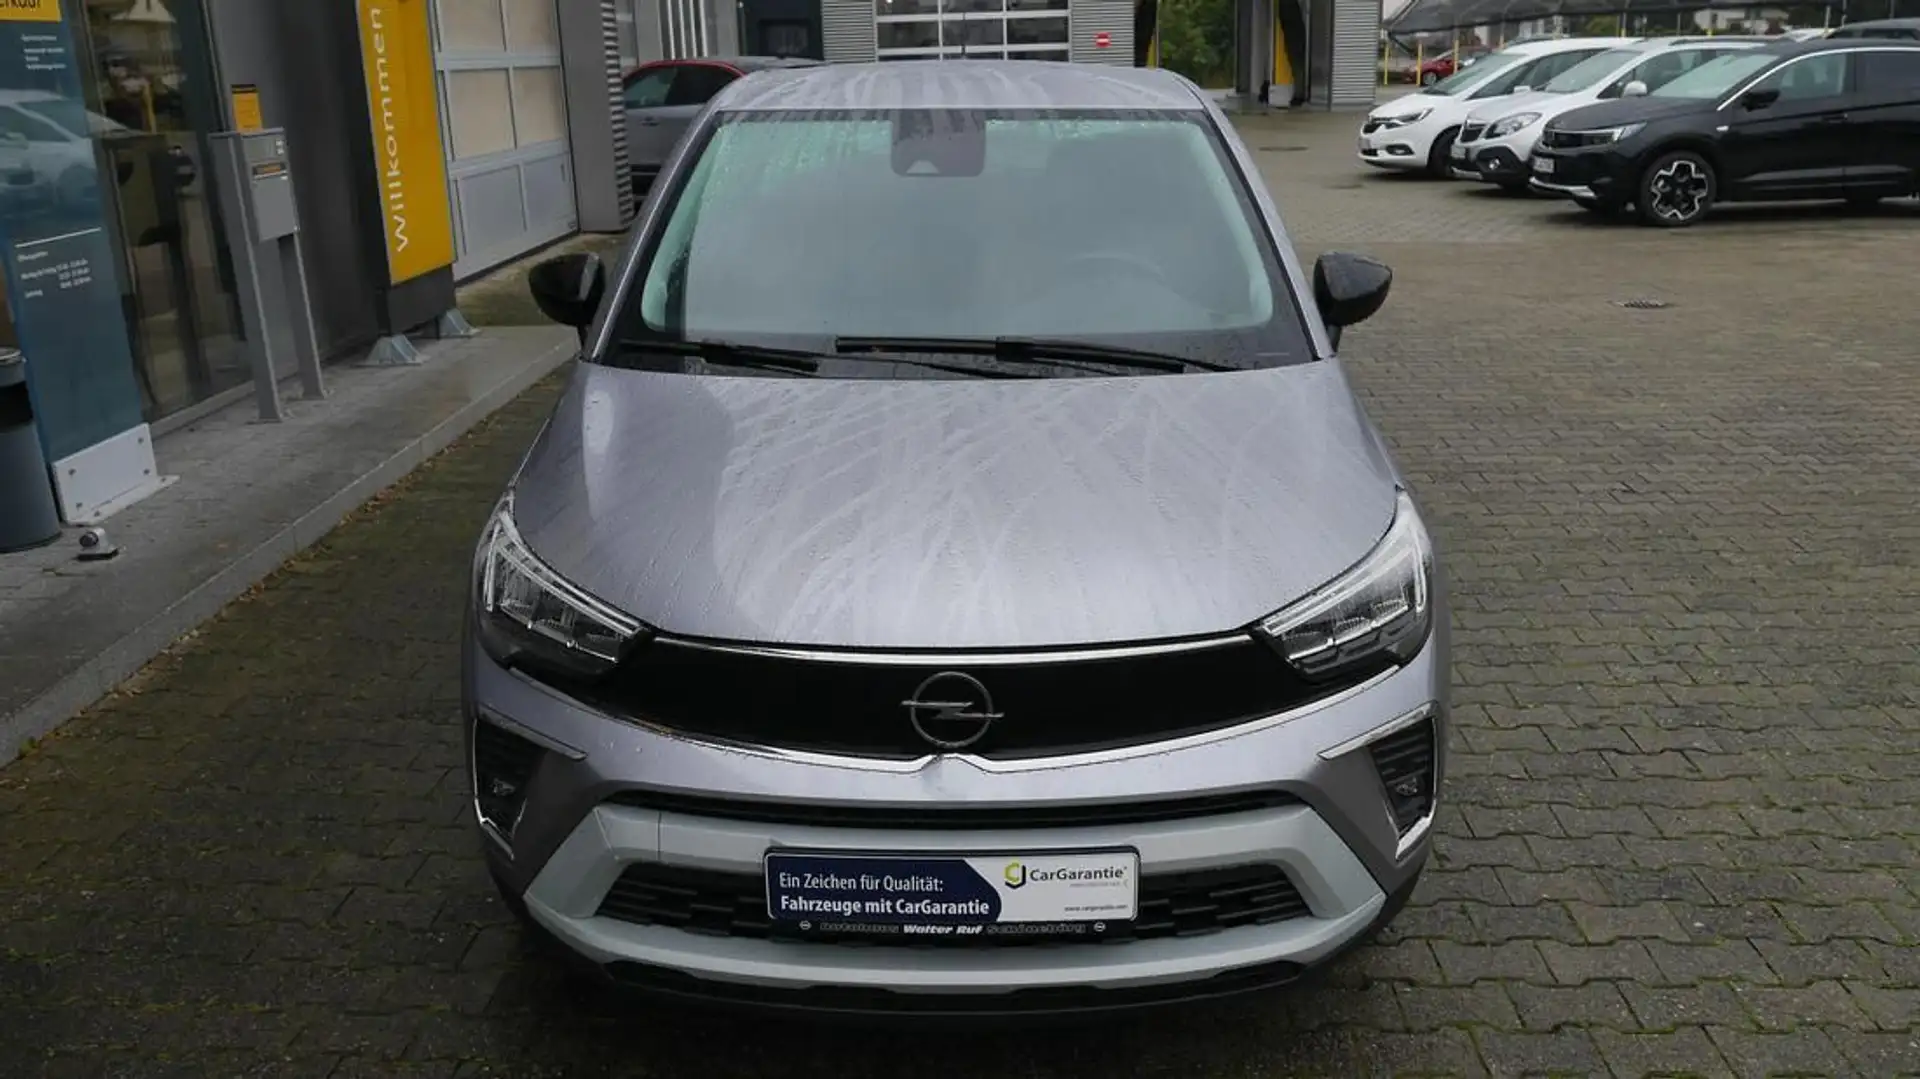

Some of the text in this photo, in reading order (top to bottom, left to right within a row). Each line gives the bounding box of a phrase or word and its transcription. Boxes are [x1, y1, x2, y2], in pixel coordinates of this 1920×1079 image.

[371, 8, 408, 252] Willkommen
[779, 872, 943, 892] Ein Zeichen für Qualität:
[781, 896, 990, 916] Fahrzeuge mit CarGarantie
[956, 924, 983, 934] Ruf
